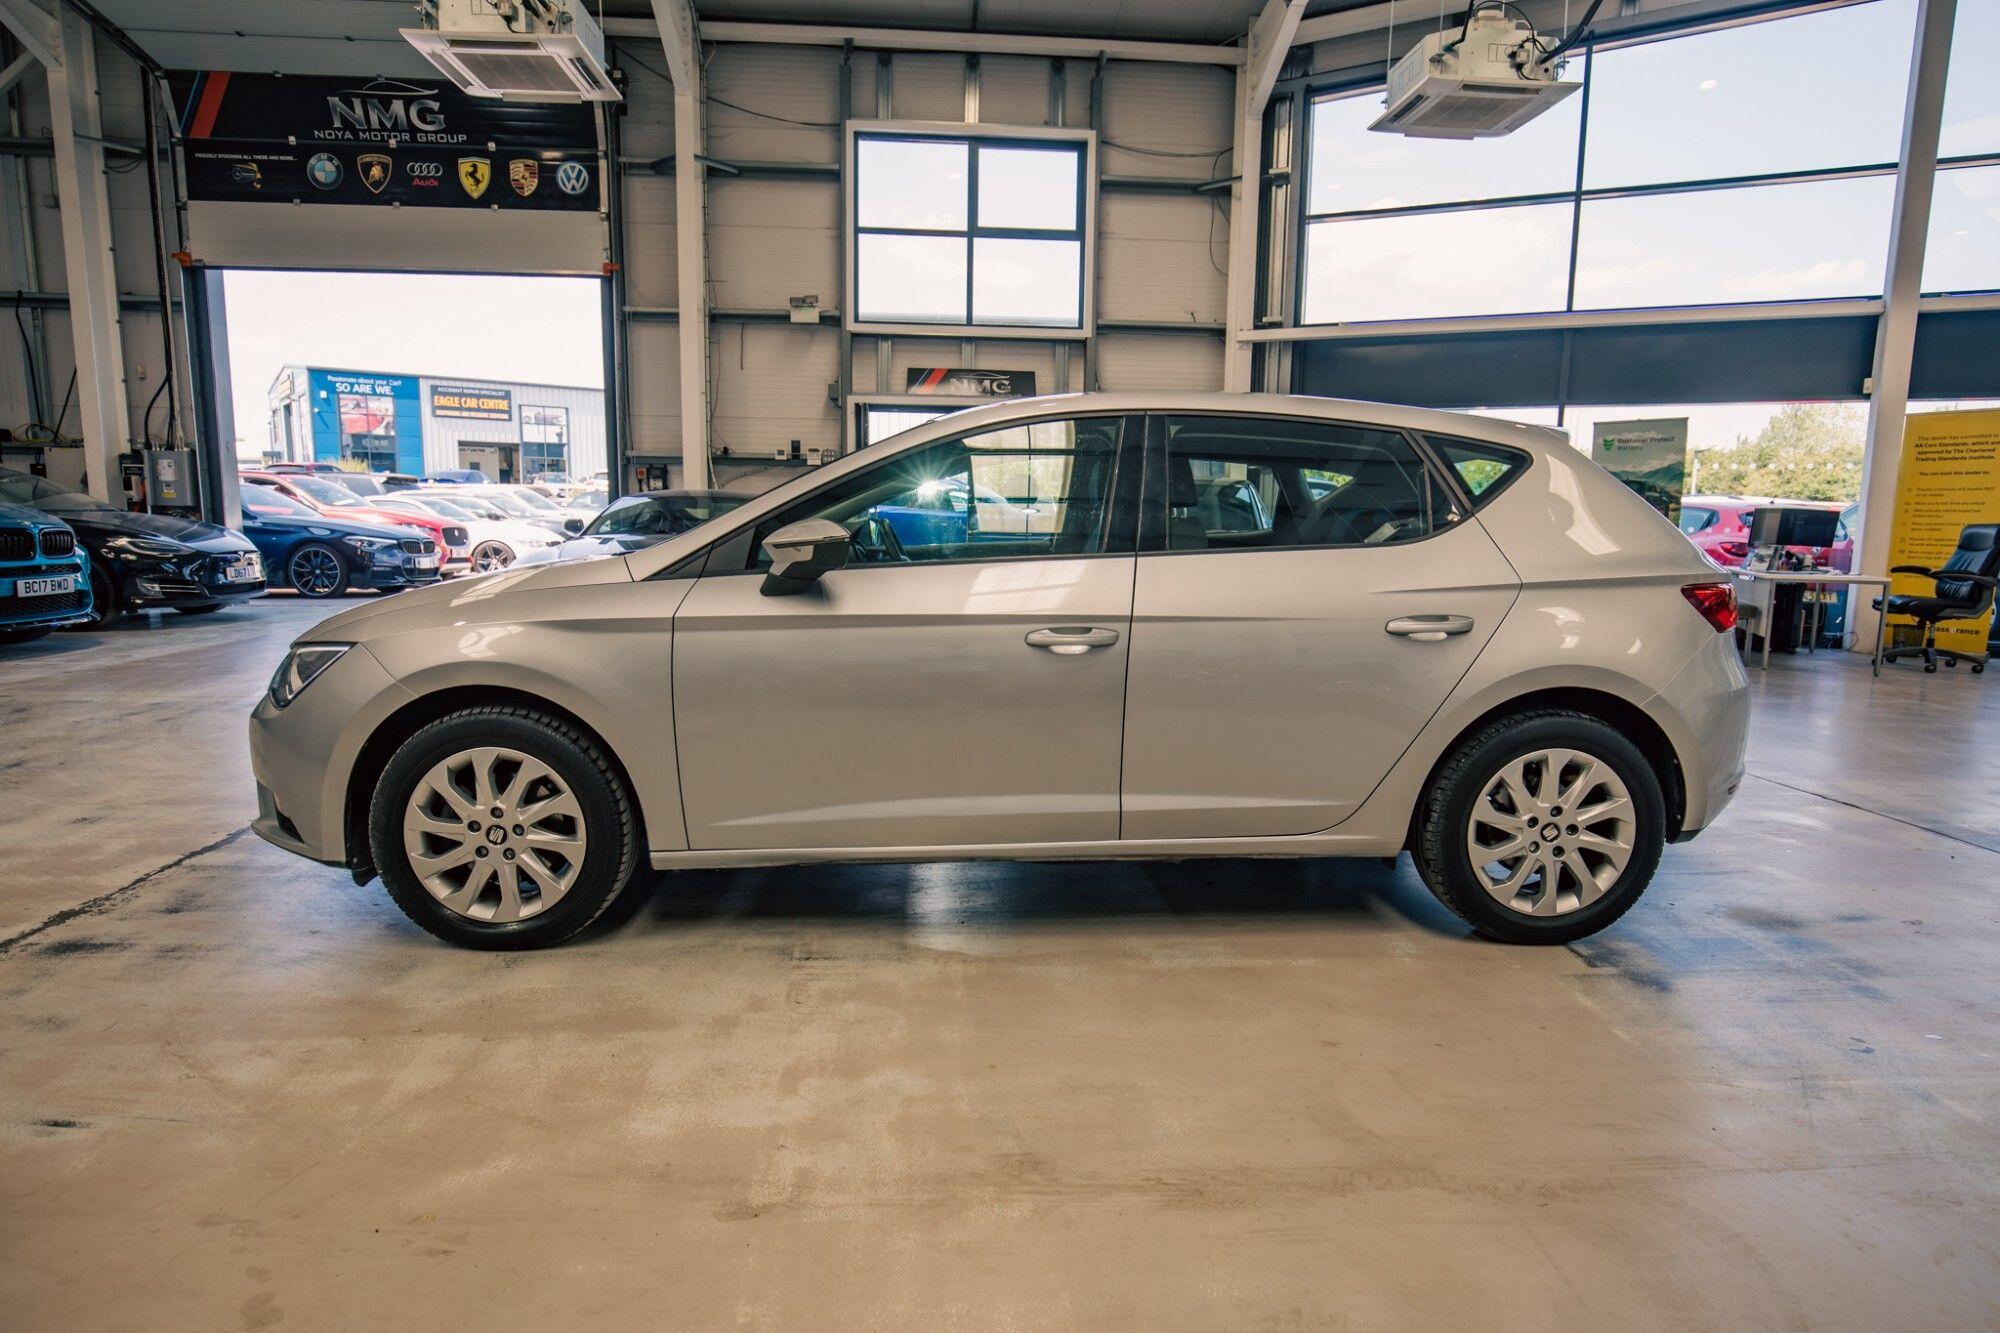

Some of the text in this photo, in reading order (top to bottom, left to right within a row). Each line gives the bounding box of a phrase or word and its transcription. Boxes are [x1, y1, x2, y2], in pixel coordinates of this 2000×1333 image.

[327, 97, 446, 131] NMG
[314, 130, 467, 143] NOYA MOTOR GROUP
[335, 382, 394, 396] SO ARE WE.
[950, 378, 1011, 393] NMG
[434, 395, 510, 410] EAGLE CAR CENTRE
[24, 580, 47, 593] BC17
